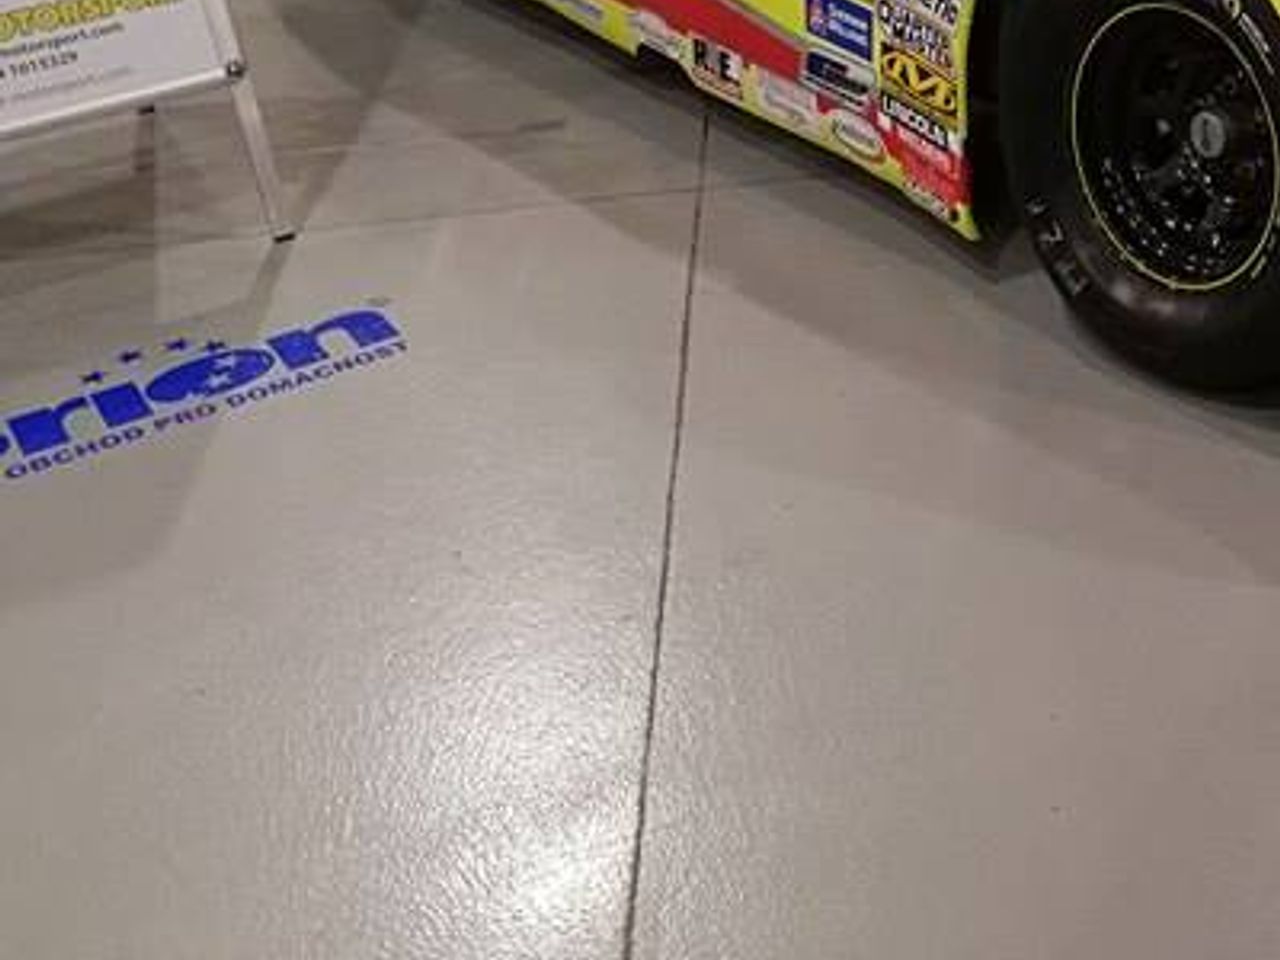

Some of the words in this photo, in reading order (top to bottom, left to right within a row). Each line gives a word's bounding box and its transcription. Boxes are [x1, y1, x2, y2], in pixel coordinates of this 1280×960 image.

[0, 311, 400, 458] rion
[4, 425, 145, 479] OBCHOD
[154, 402, 217, 433] PRO
